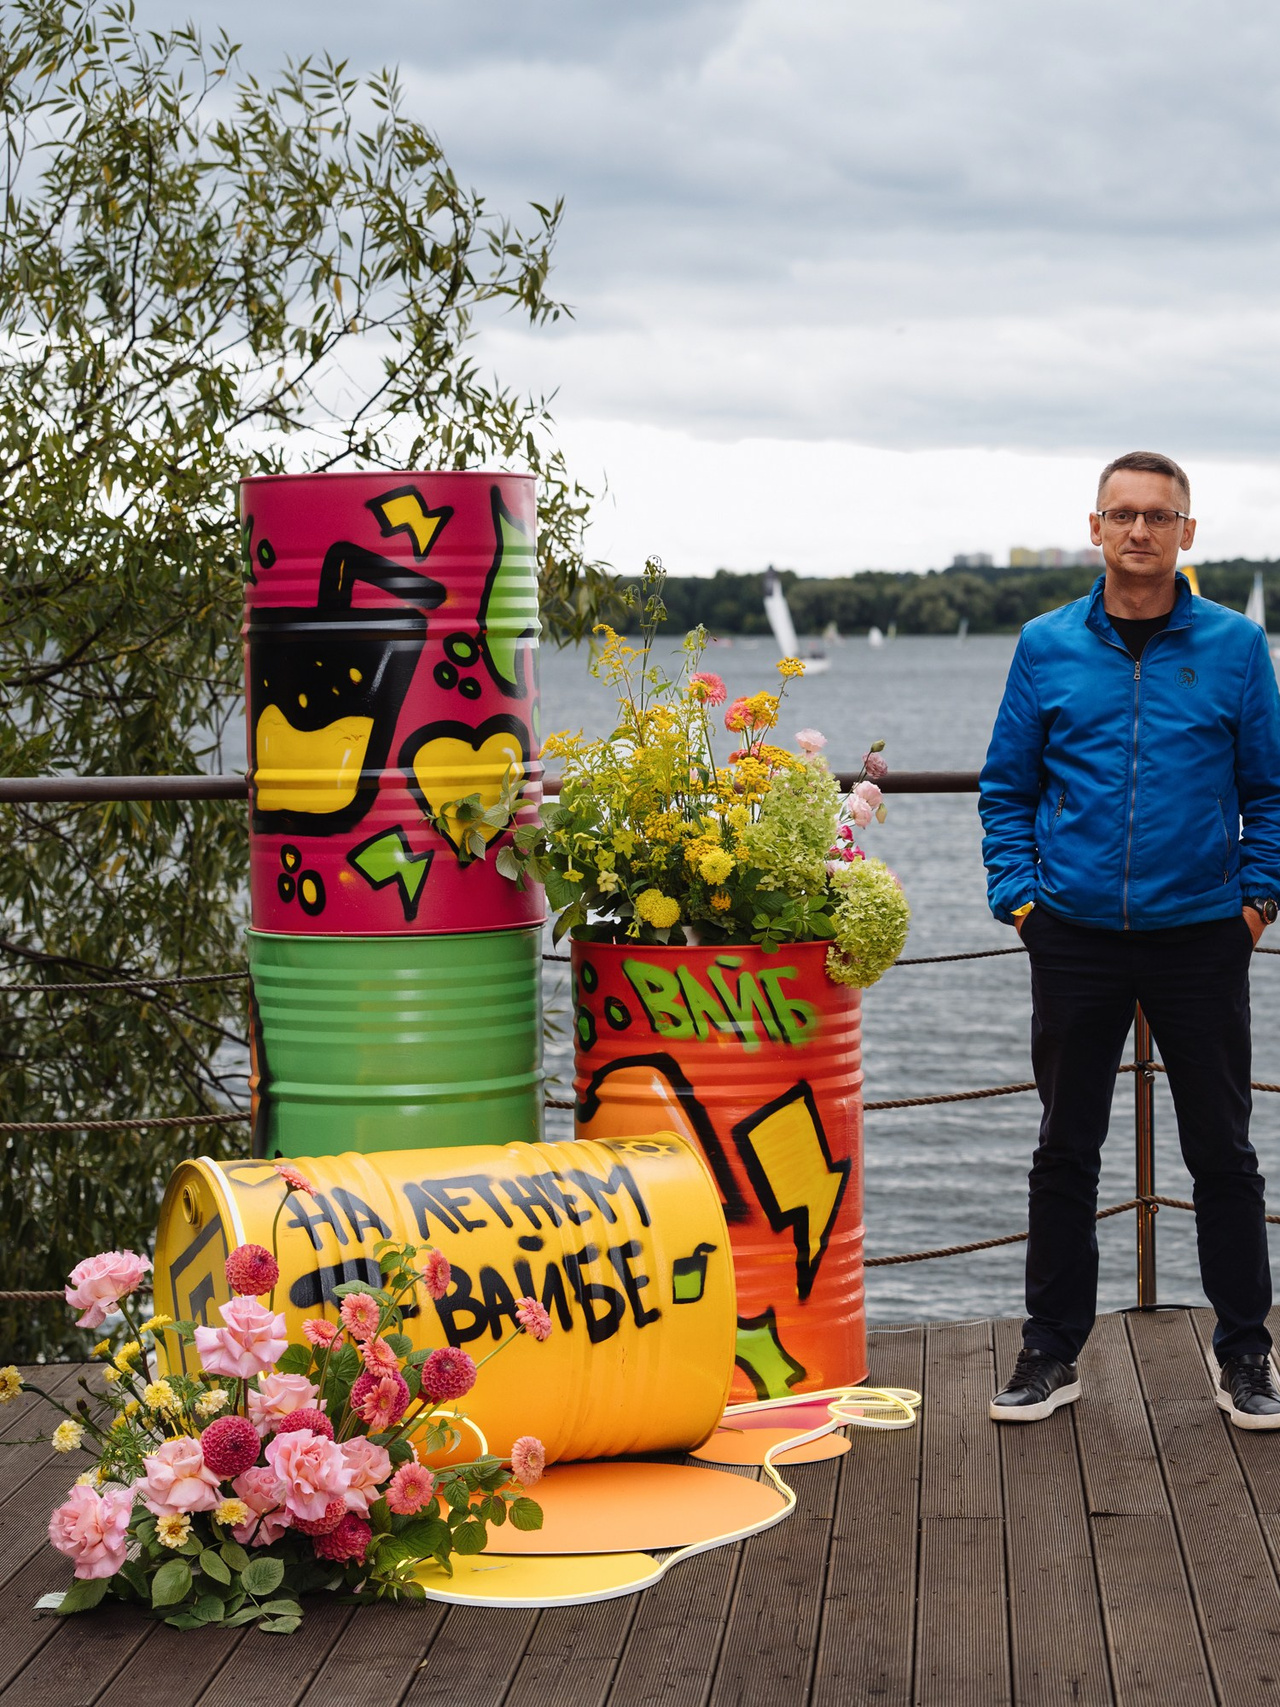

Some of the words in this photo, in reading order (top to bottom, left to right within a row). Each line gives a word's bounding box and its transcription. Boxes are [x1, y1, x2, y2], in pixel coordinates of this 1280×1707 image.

[622, 955, 818, 1054] ВАЙБ
[287, 1186, 393, 1251] НА
[403, 1165, 650, 1240] ЛЕТНЕМ
